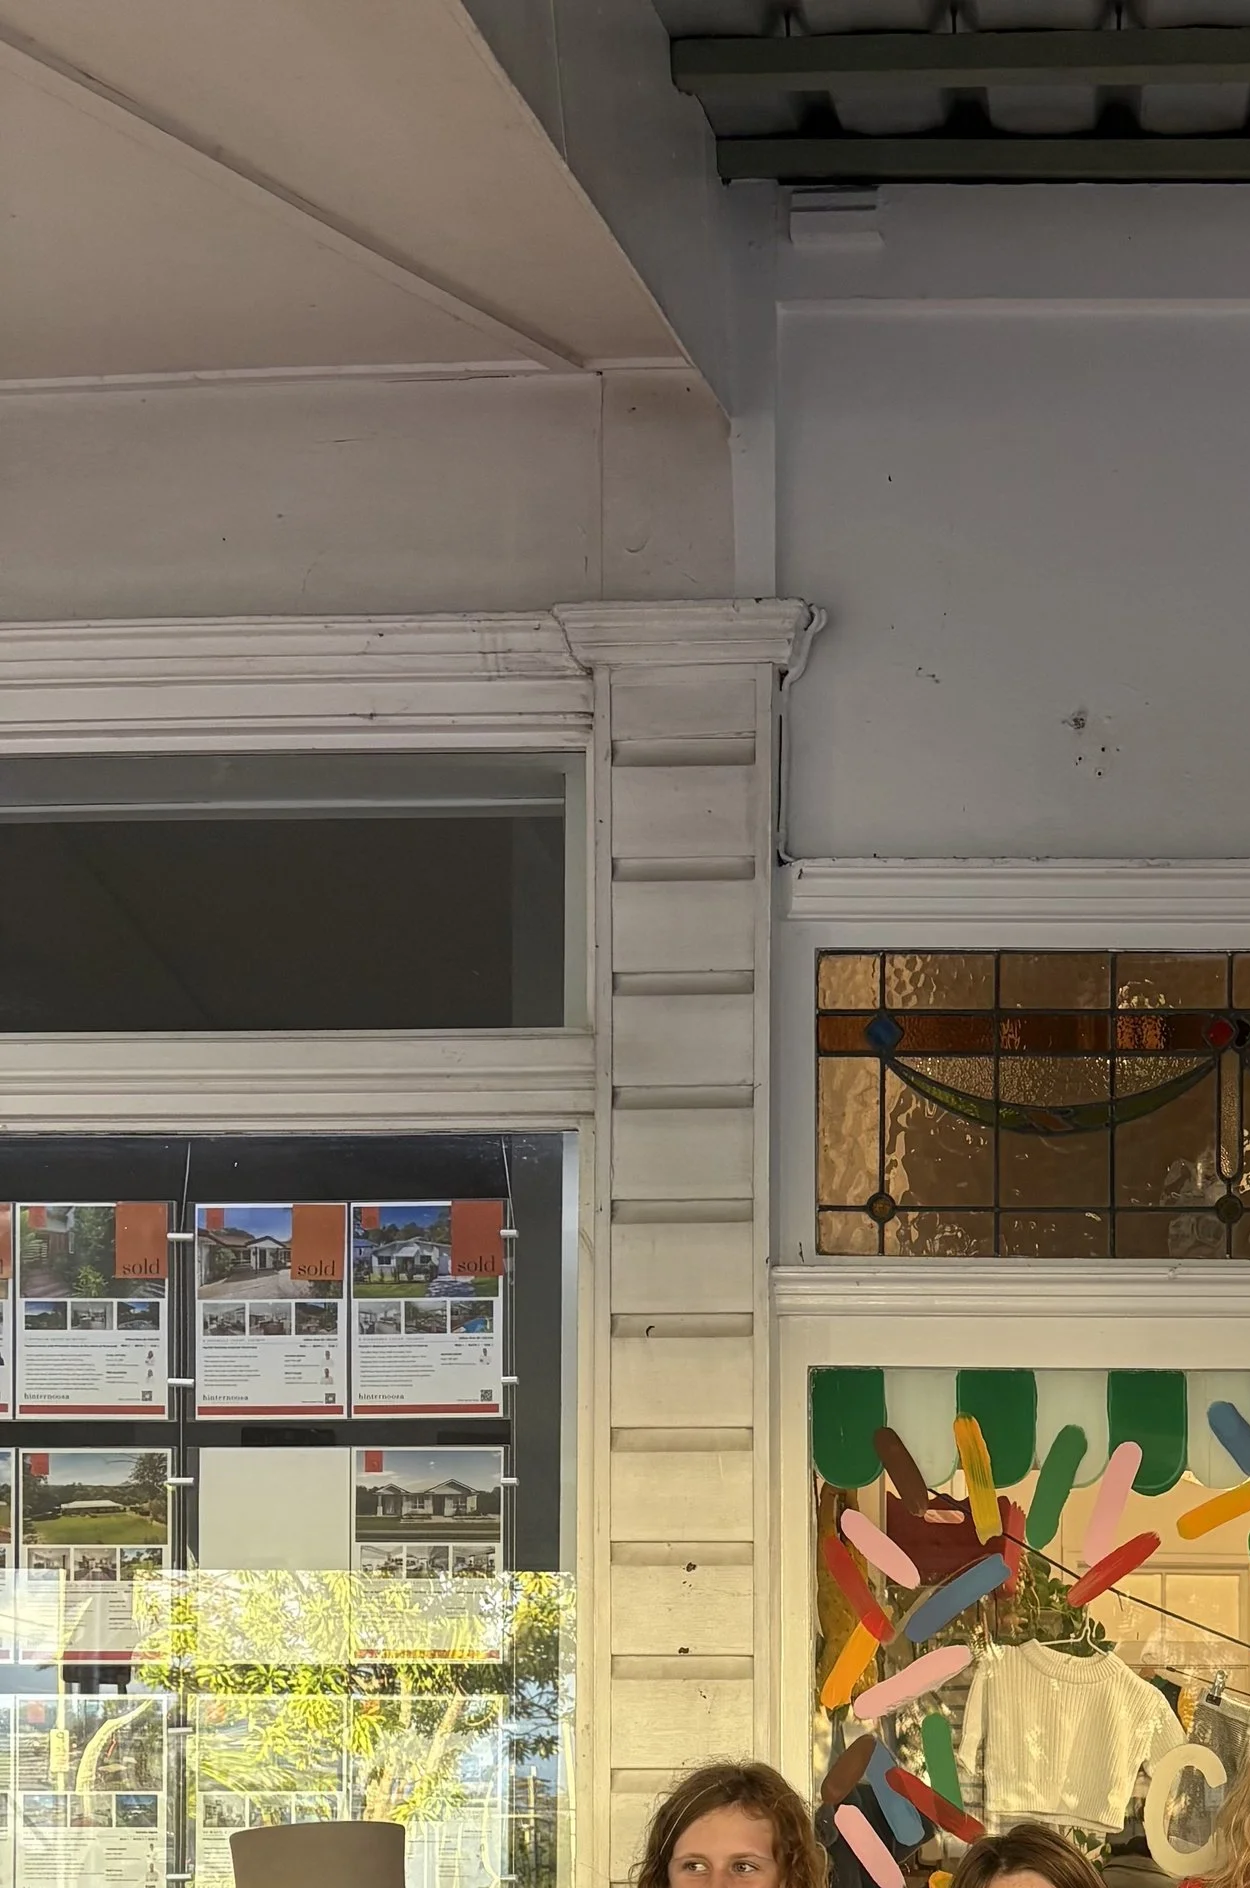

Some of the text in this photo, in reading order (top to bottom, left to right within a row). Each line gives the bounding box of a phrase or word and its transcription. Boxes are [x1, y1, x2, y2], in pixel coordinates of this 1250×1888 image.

[122, 1258, 160, 1275] sold
[298, 1260, 335, 1276] sold
[457, 1255, 495, 1273] sold
[24, 1392, 70, 1400] hinternoosa
[358, 1392, 404, 1400] hinternoosa
